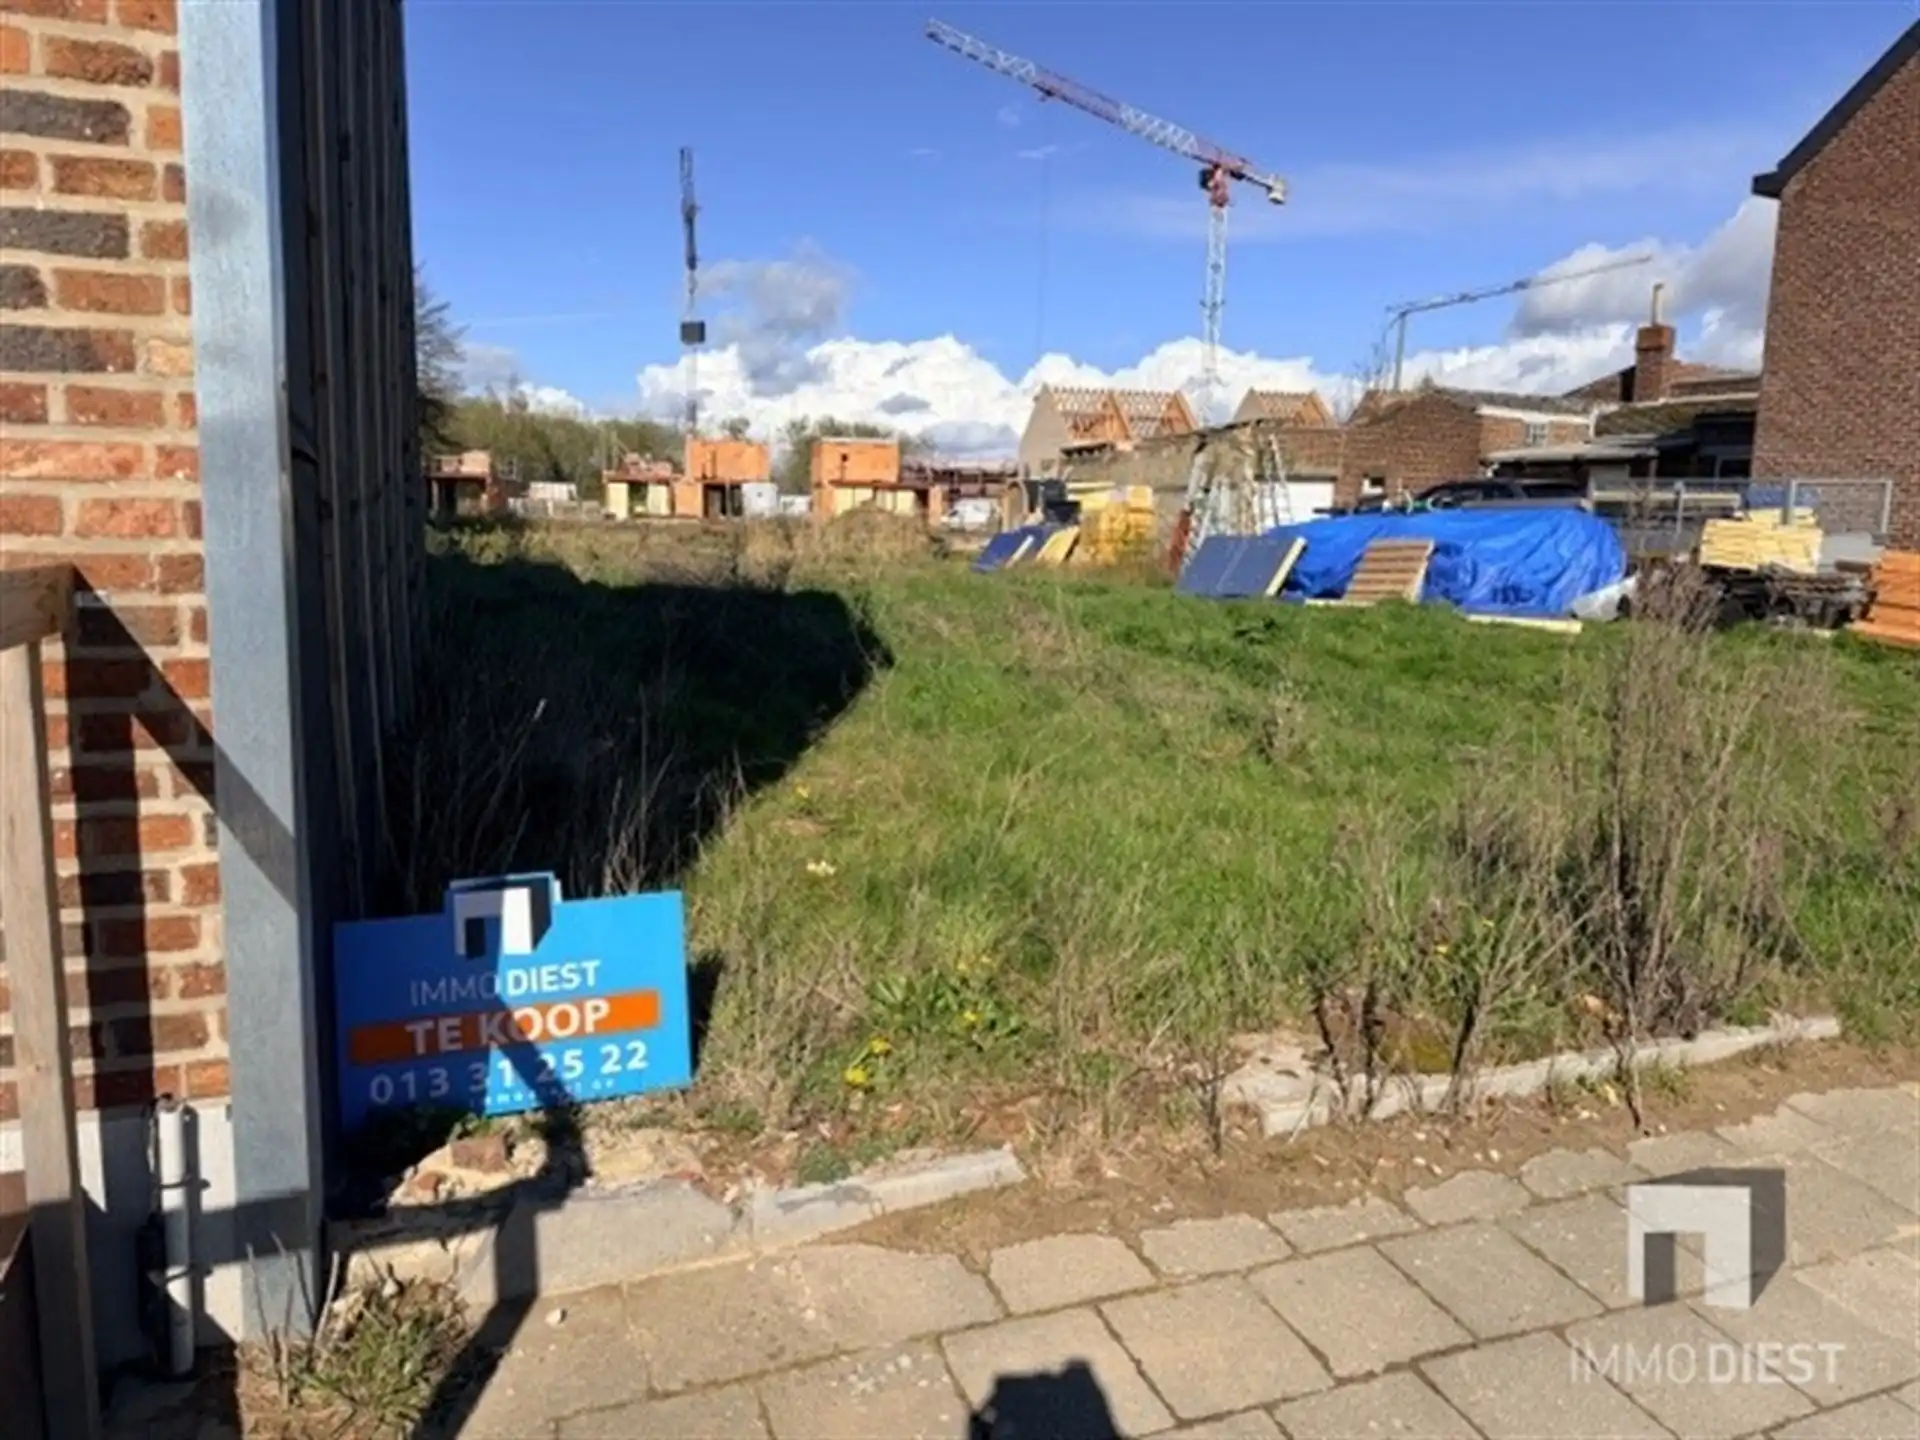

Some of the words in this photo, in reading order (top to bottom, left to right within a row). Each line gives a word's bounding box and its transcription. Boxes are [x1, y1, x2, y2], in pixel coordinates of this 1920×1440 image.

[404, 1016, 463, 1055] TE
[479, 998, 611, 1045] KOOP
[370, 1067, 450, 1105] 013
[468, 1059, 517, 1091] 31
[536, 1048, 584, 1082] 25
[600, 1040, 649, 1075] 22
